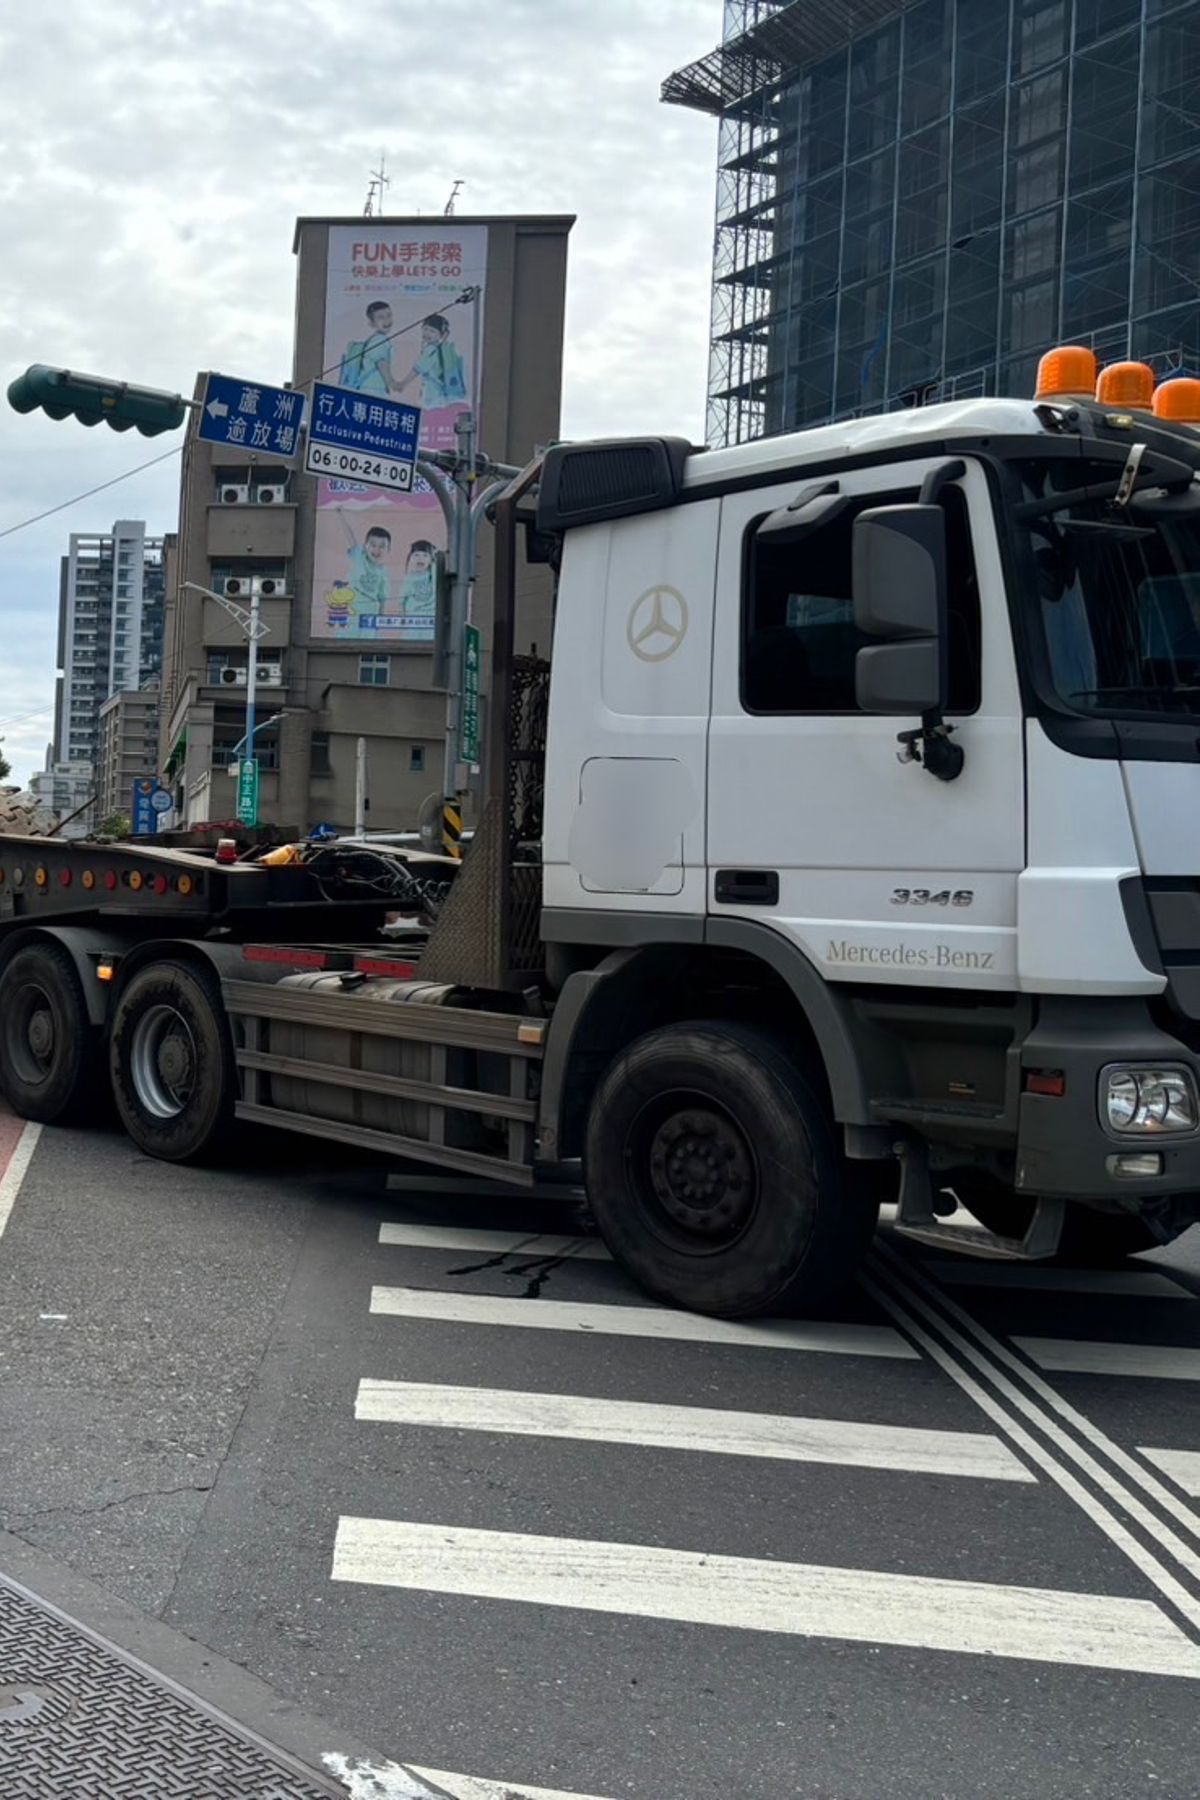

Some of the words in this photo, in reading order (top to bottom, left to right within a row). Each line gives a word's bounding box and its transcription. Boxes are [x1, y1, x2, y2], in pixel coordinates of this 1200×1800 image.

[352, 242, 462, 262] FUN手探索
[440, 266, 461, 277] GO
[238, 386, 295, 422] 蘆洲
[318, 393, 416, 434] 行人專用時相
[315, 420, 362, 441] Exclusive
[363, 431, 413, 452] Pedestrian
[889, 888, 974, 907] 3346
[826, 940, 996, 970] Mercedes-Benz
